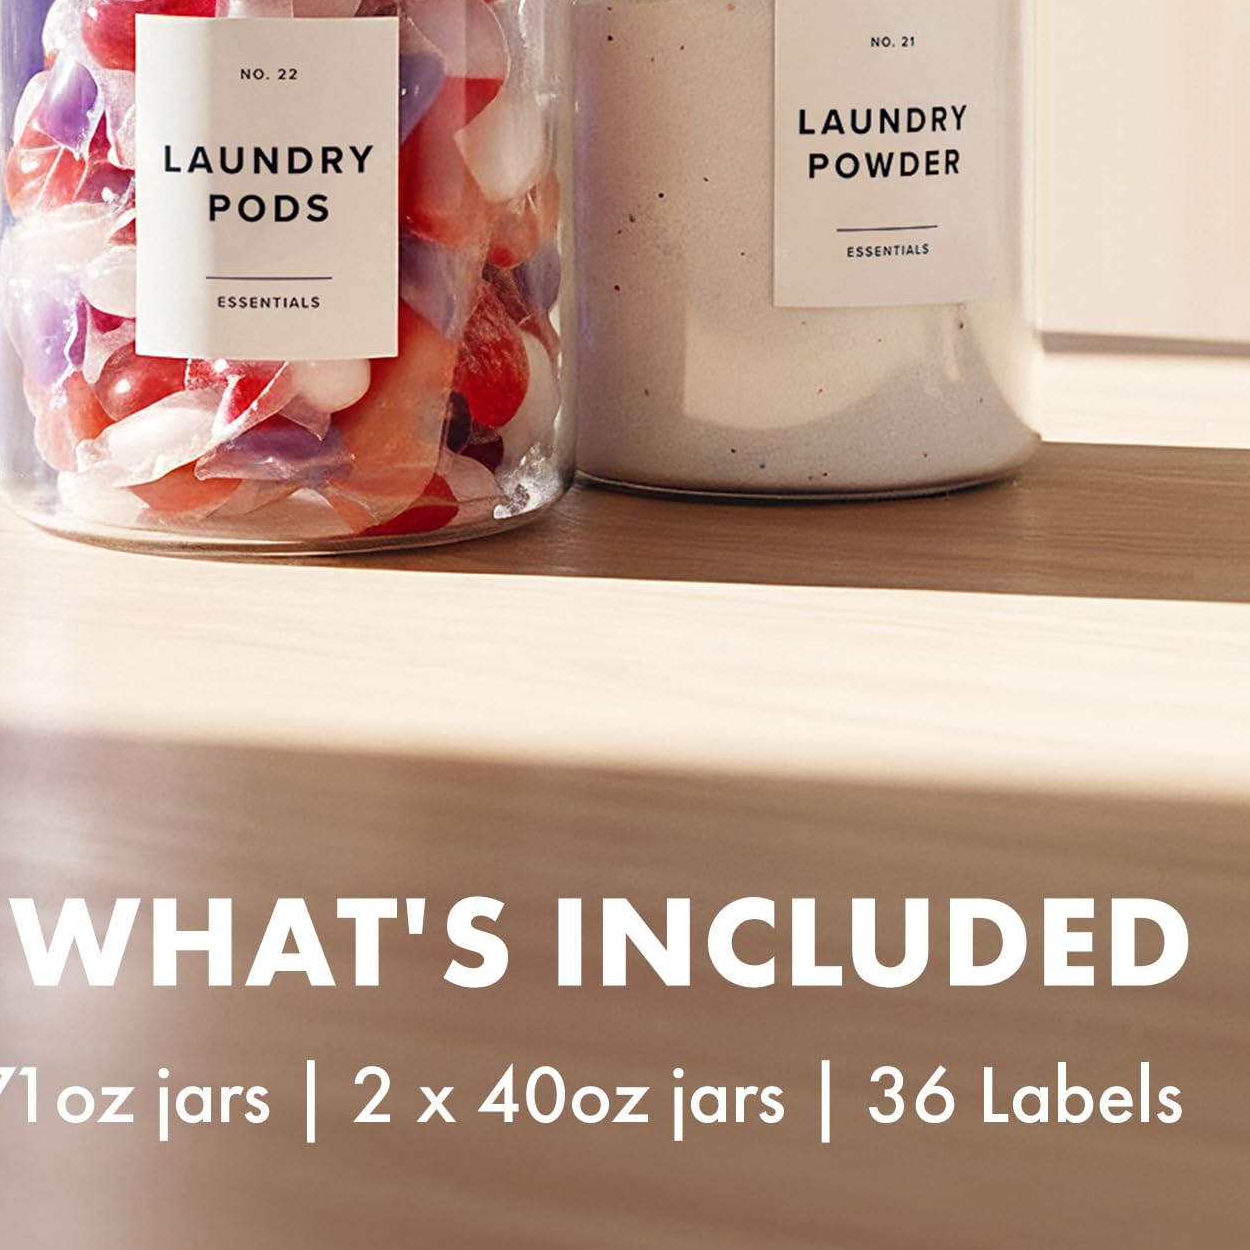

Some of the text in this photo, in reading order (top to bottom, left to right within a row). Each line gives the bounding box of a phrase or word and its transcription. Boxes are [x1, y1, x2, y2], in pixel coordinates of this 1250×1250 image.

[870, 35, 915, 48] NO. 21
[240, 67, 298, 81] NO. 22
[798, 104, 967, 135] LAUNDRY
[164, 144, 374, 175] LAUNDRY
[808, 148, 960, 180] POWDER
[208, 193, 329, 223] PODS
[846, 243, 930, 258] ESSENTIALS
[217, 295, 321, 309] ESSENTIALS
